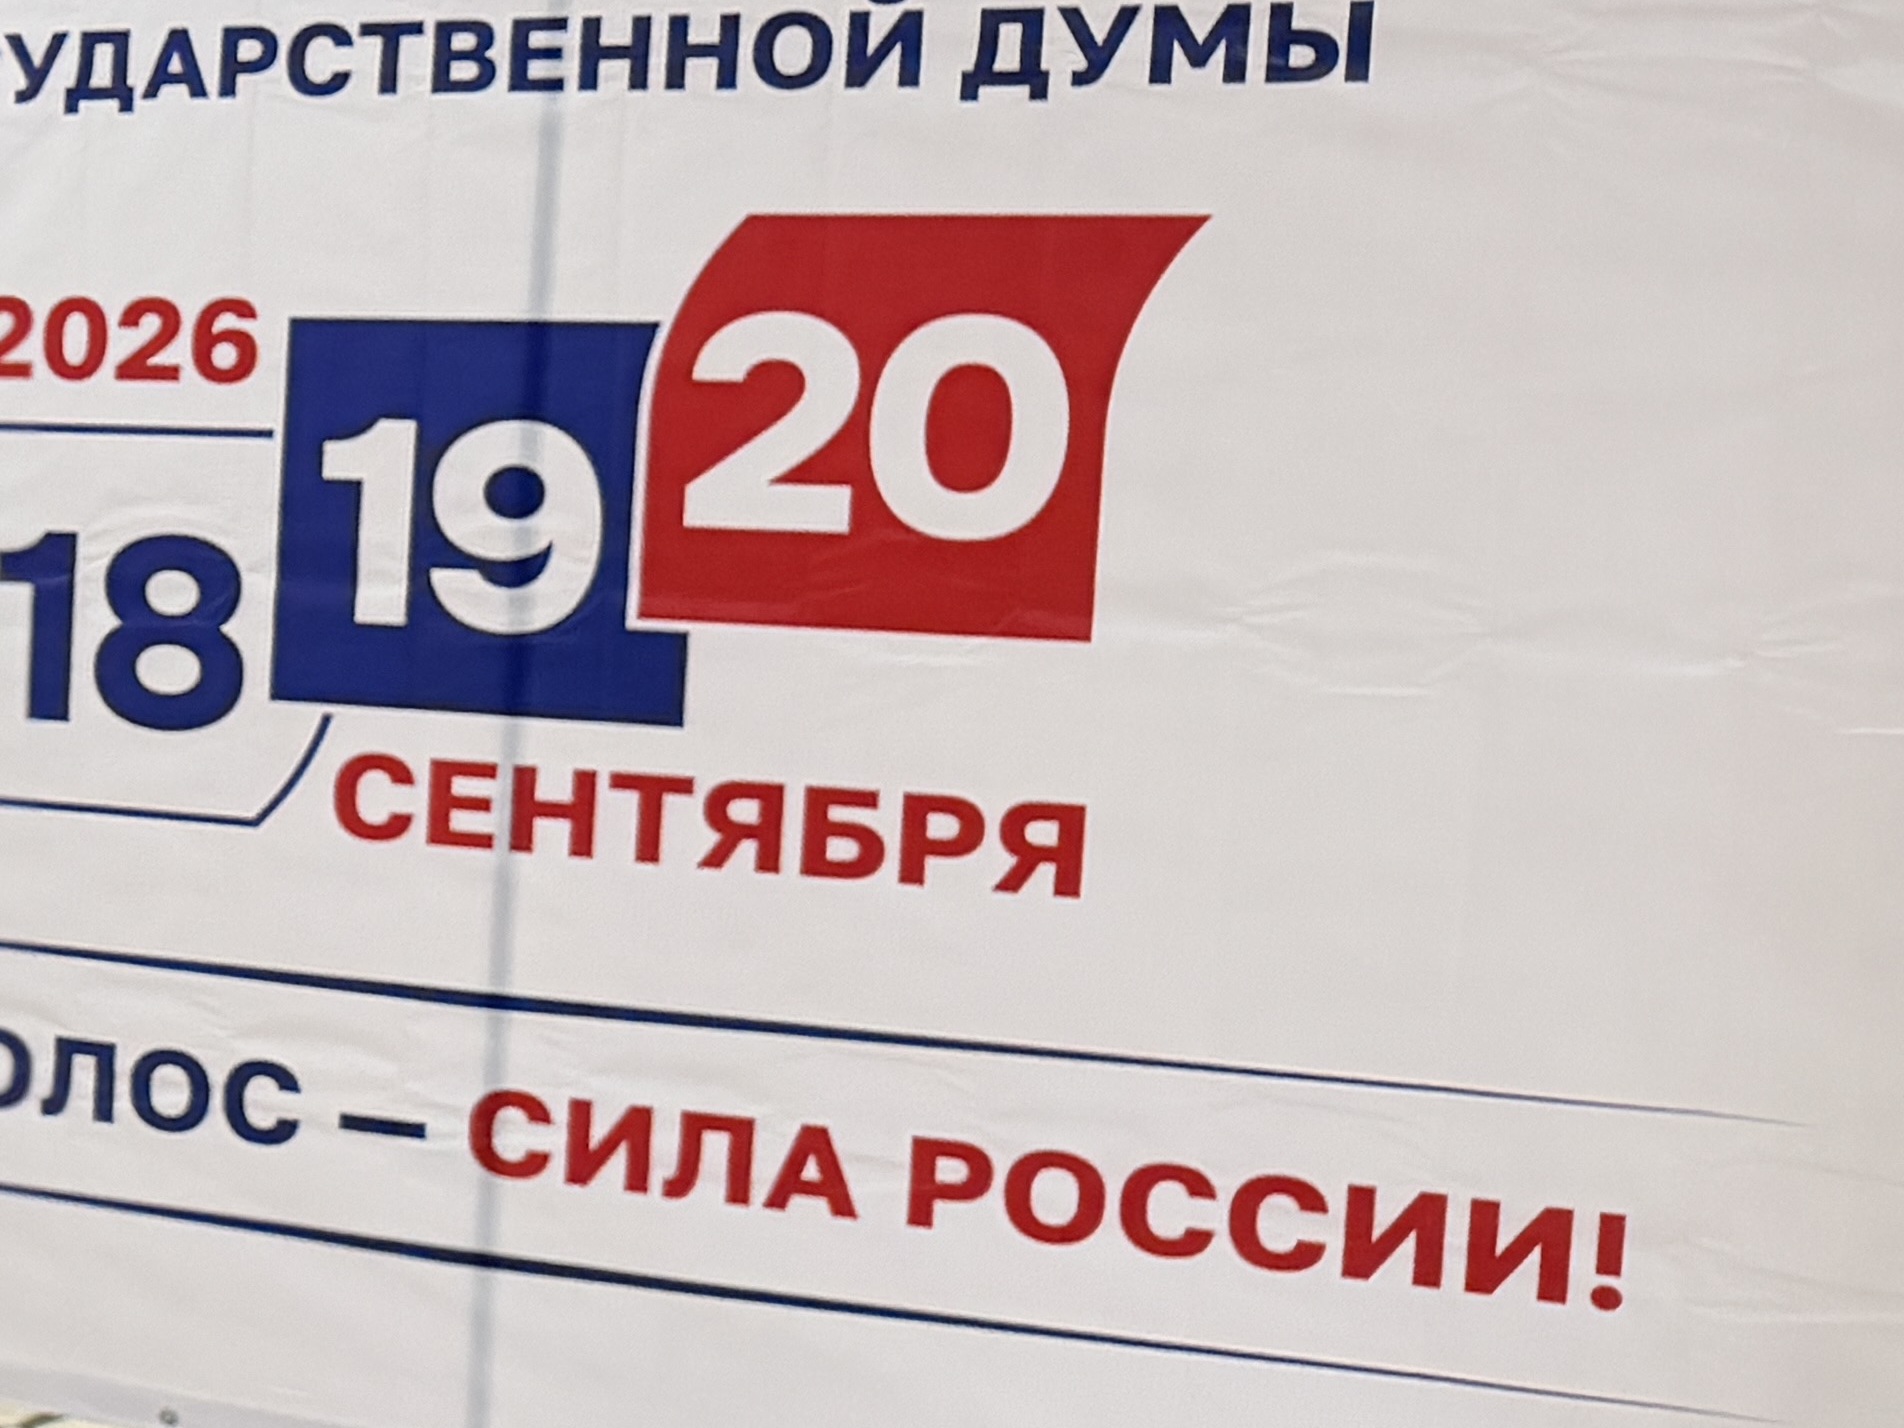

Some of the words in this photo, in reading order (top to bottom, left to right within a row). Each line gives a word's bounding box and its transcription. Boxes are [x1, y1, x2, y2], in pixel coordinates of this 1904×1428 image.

[960, 0, 1375, 101] ДУМЫ
[322, 418, 602, 634] 19
[680, 310, 1072, 540] 20
[334, 753, 1087, 899] СЕНТЯБРЯ
[469, 1090, 858, 1220] СИЛА
[907, 1137, 1627, 1312] РОССИИ!
